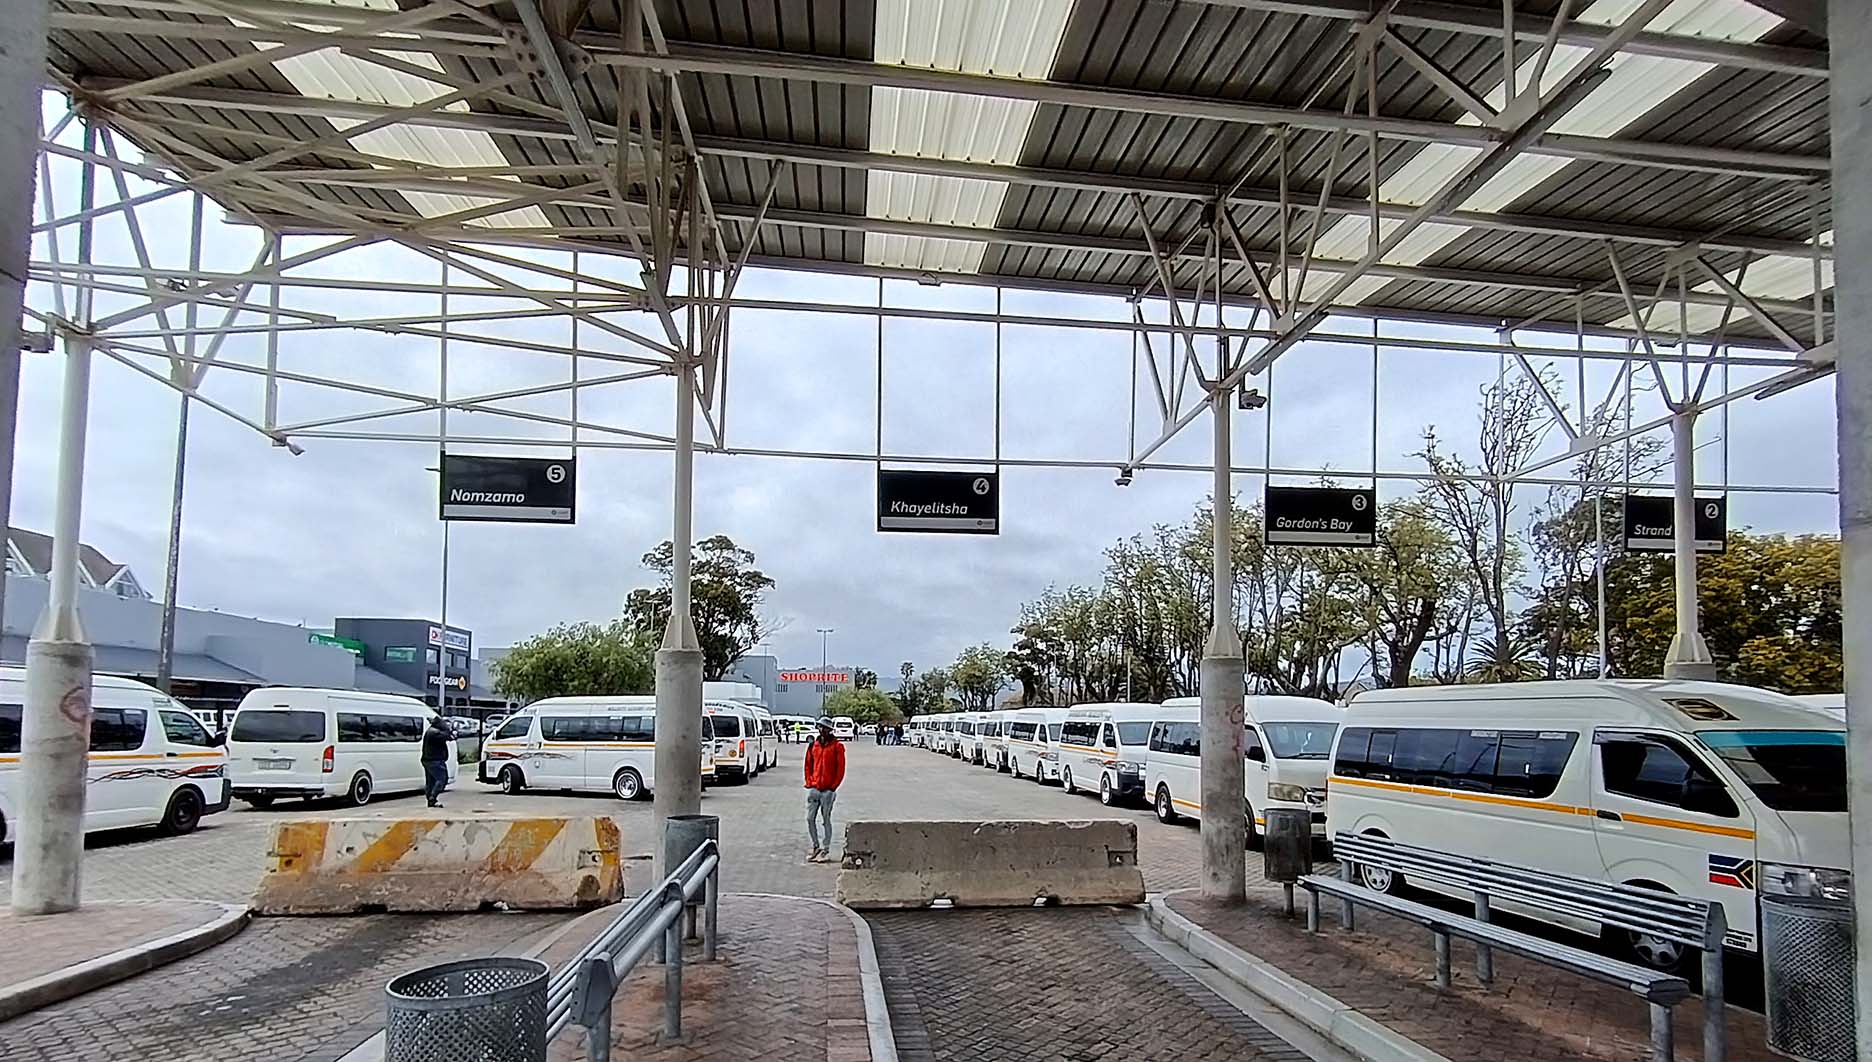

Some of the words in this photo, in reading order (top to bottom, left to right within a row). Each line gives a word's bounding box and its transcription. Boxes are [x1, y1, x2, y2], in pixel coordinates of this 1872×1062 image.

[450, 488, 525, 503] Nomzamo
[890, 500, 968, 516] Khayelitsha
[1276, 517, 1328, 530] Gordon's
[1330, 518, 1353, 532] Bay
[1634, 524, 1672, 536] Strand
[429, 676, 459, 686] FOOGEAR
[780, 672, 848, 683] SHOPRITE
